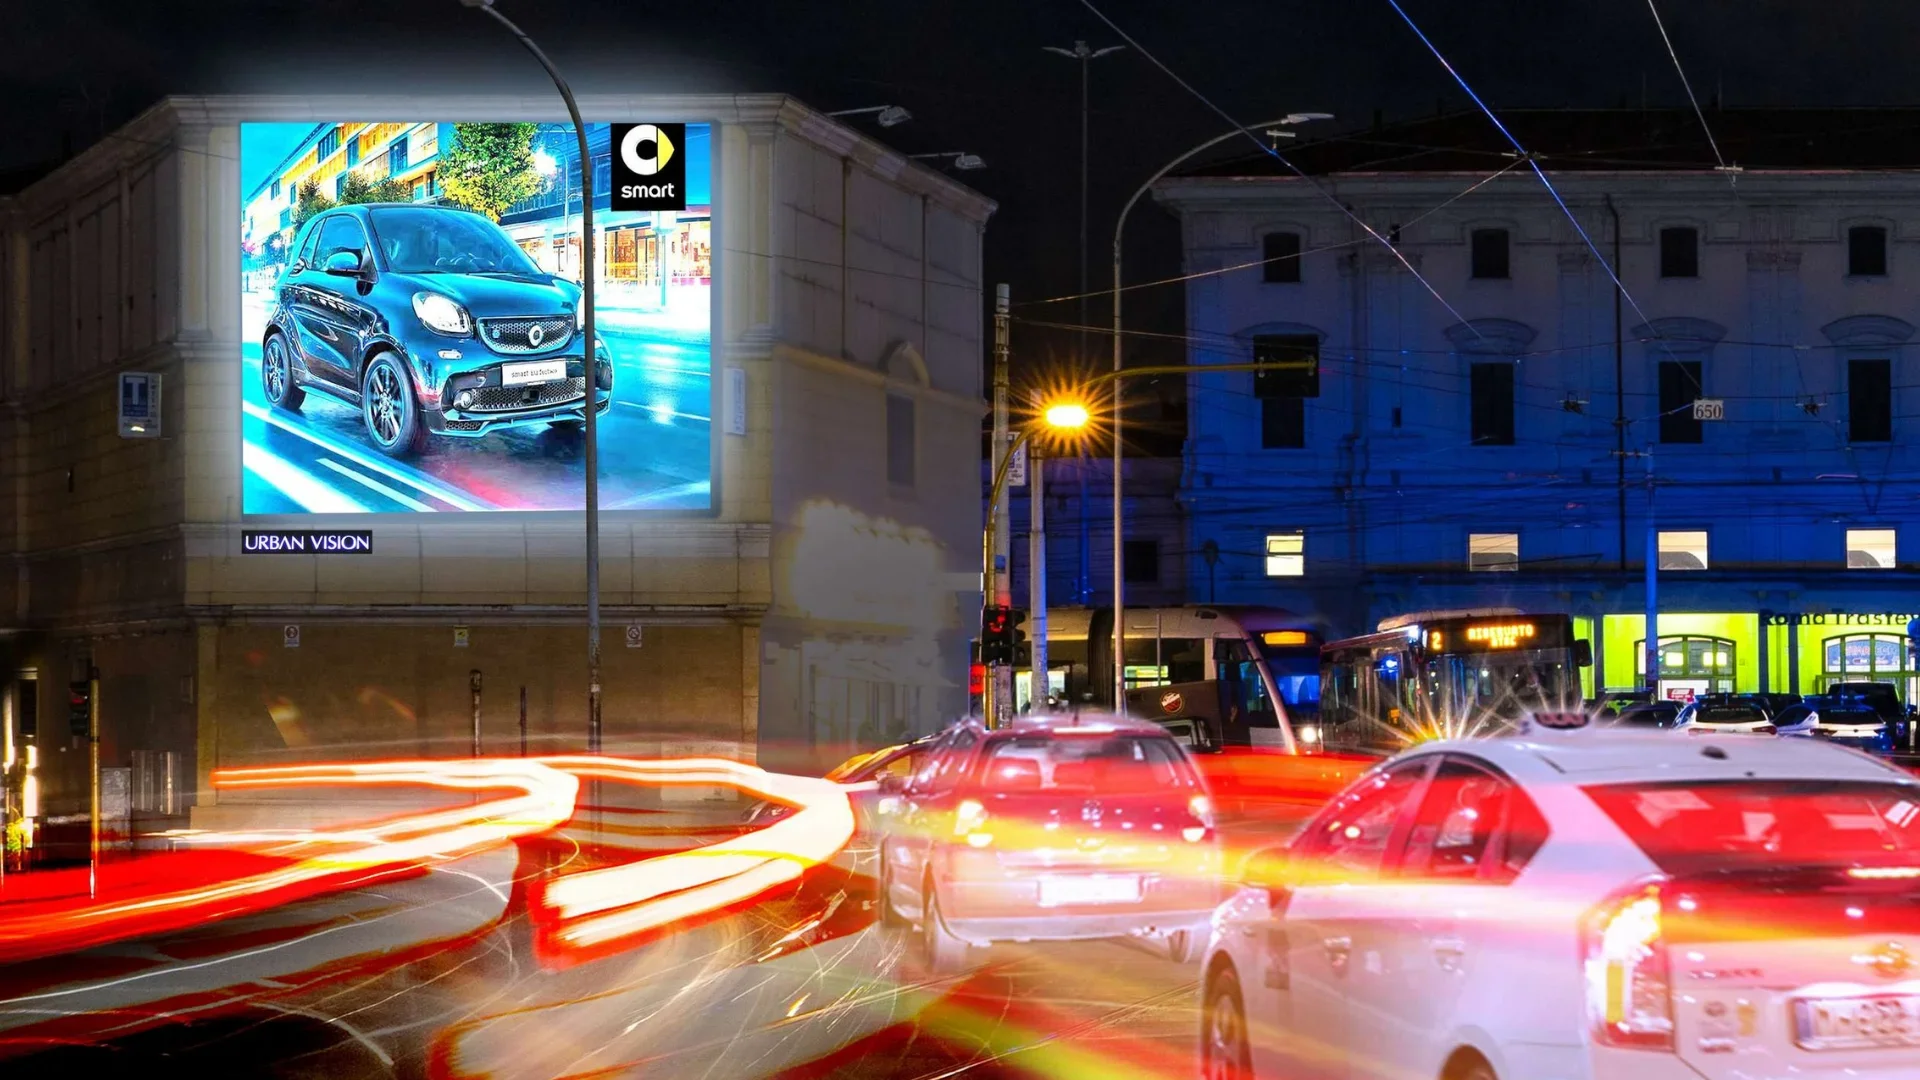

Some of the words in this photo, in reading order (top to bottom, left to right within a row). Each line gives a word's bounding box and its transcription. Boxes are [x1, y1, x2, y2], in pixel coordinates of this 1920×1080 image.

[621, 183, 675, 198] smart
[1695, 404, 1722, 418] 650
[245, 535, 304, 550] URBAN
[310, 535, 370, 550] VISION
[1431, 631, 1442, 650] 2
